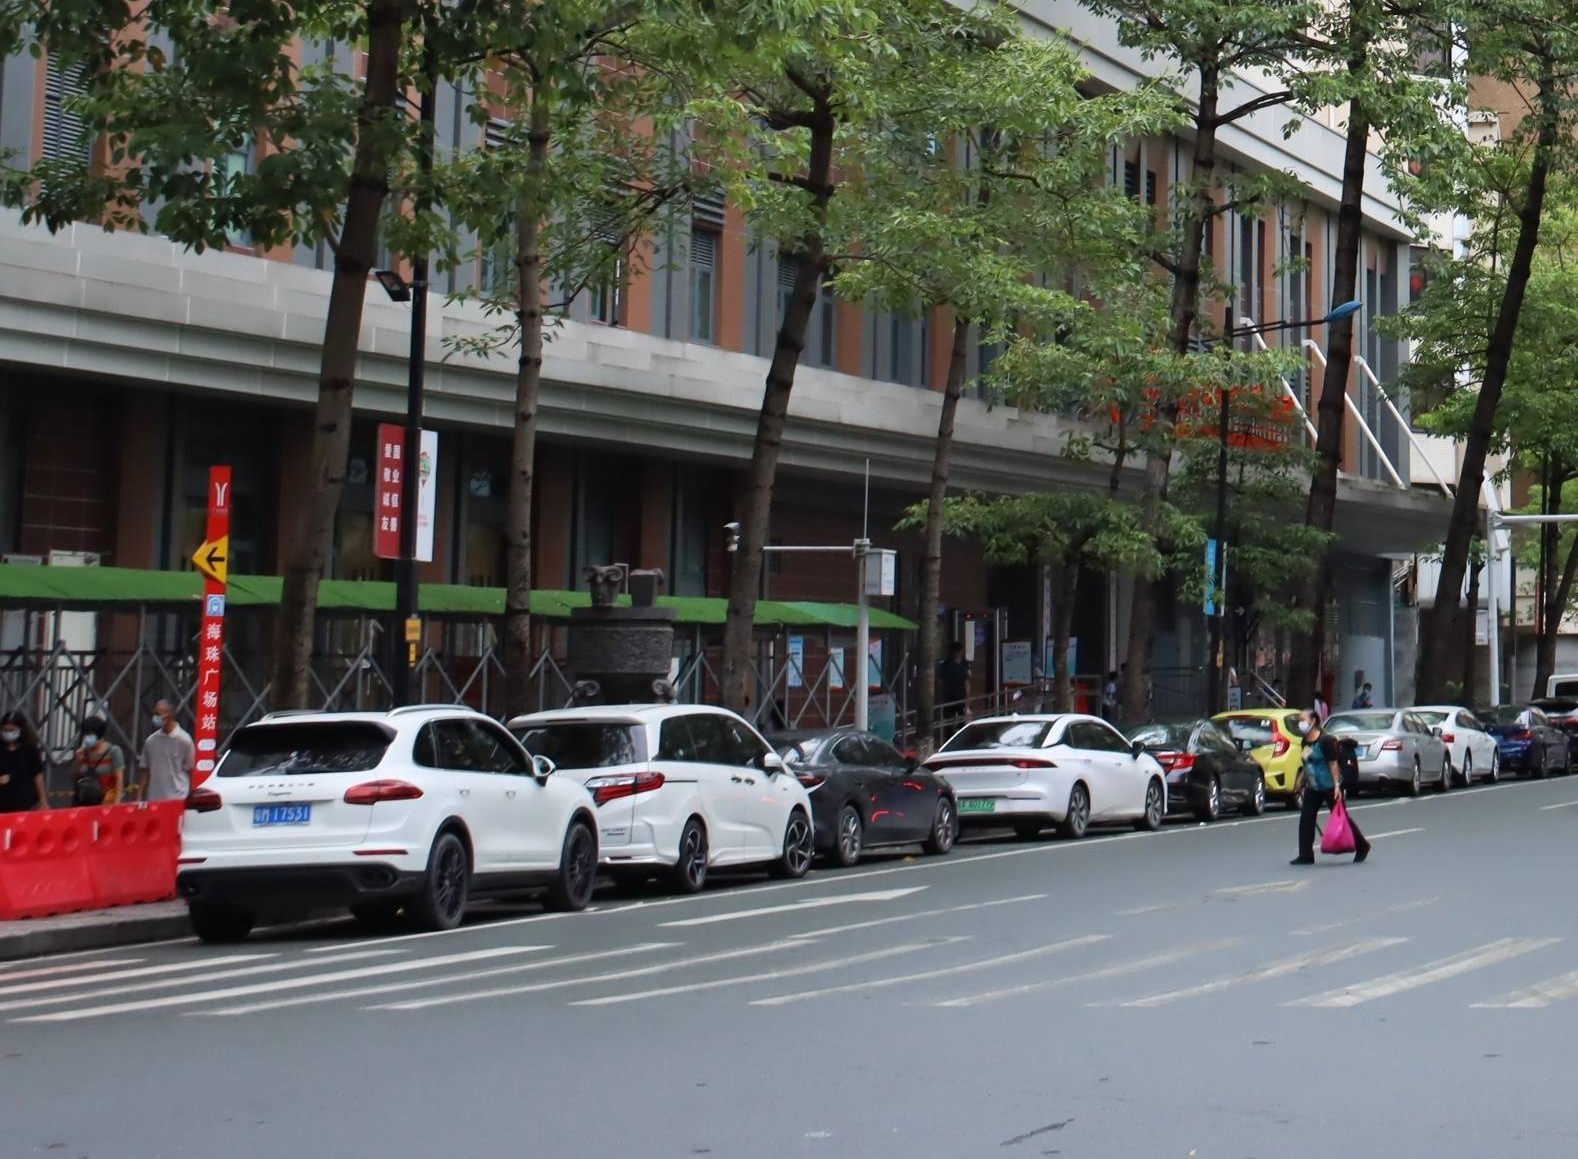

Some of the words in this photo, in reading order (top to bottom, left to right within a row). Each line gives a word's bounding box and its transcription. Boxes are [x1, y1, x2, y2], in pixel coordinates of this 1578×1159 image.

[200, 622, 223, 731] 海珠广场站
